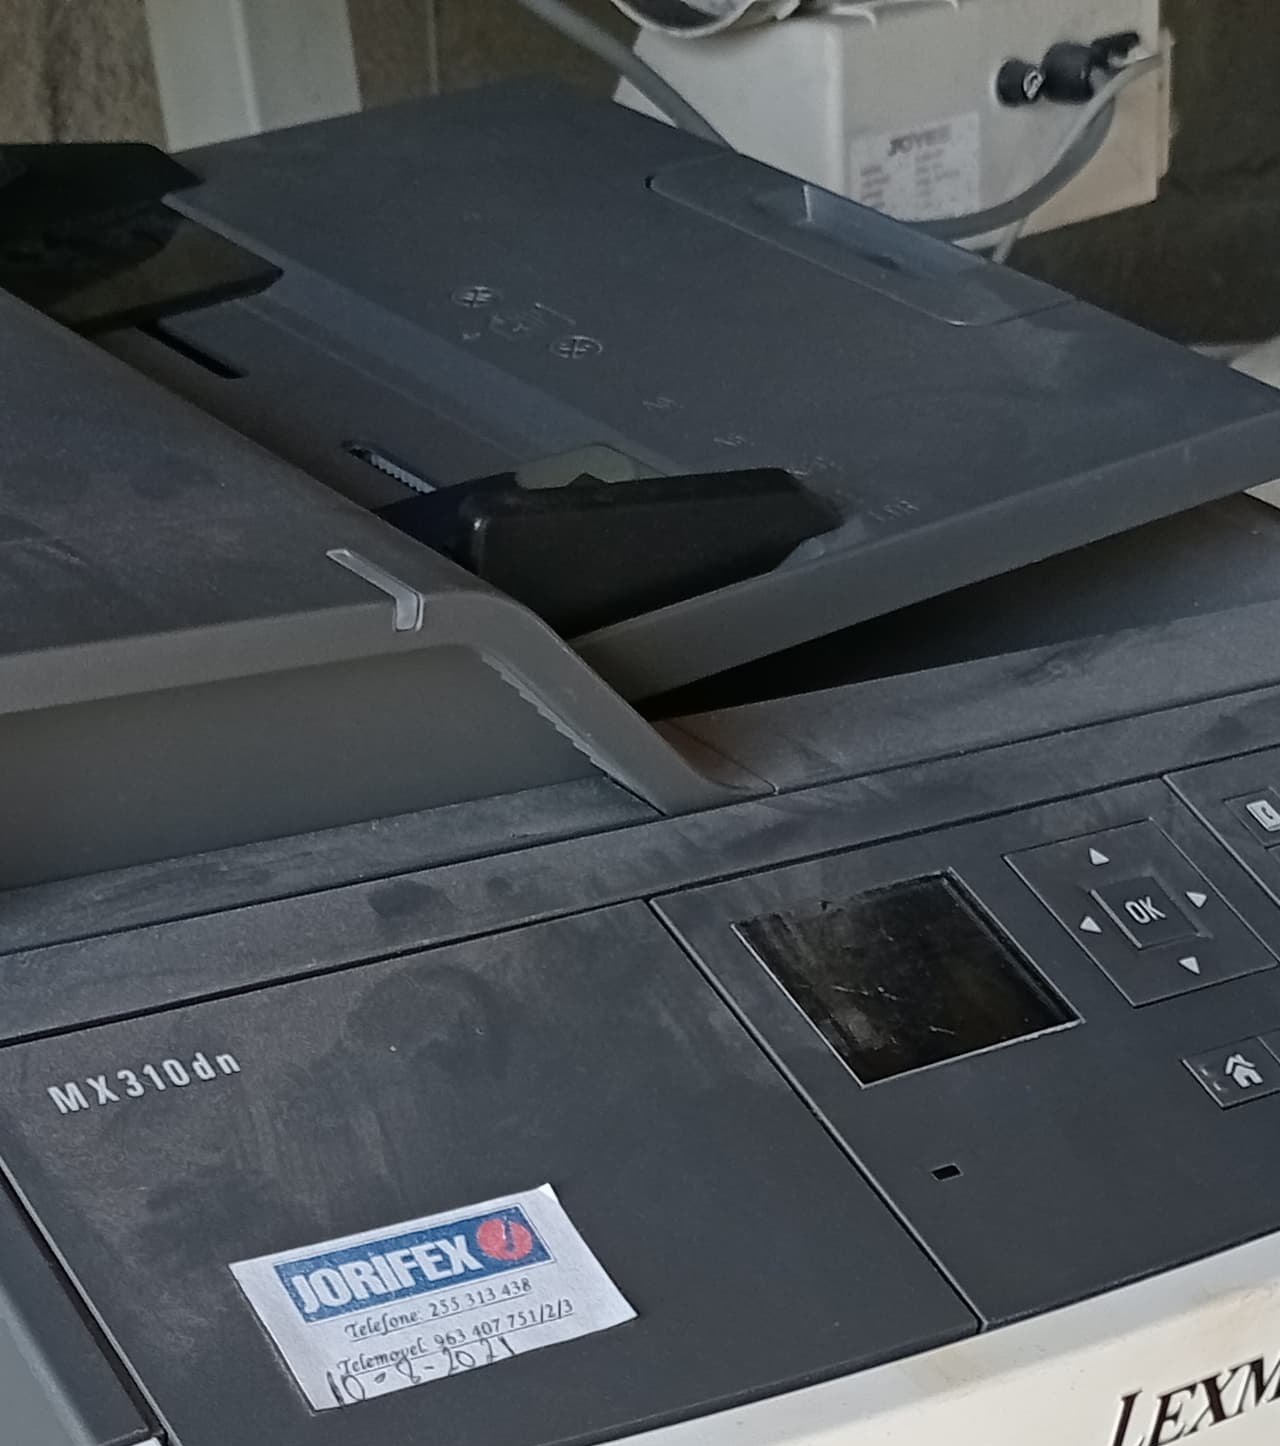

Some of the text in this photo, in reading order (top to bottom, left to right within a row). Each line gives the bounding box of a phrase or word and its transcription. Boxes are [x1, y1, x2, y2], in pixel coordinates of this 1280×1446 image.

[1124, 895, 1167, 924] OK
[47, 1051, 241, 1115] MX310dn
[291, 1234, 484, 1315] JORIFEX
[429, 1296, 461, 1318] 255
[465, 1287, 496, 1307] 313
[502, 1277, 533, 1297] 438
[433, 1328, 467, 1346] 963
[472, 1318, 501, 1339] 407
